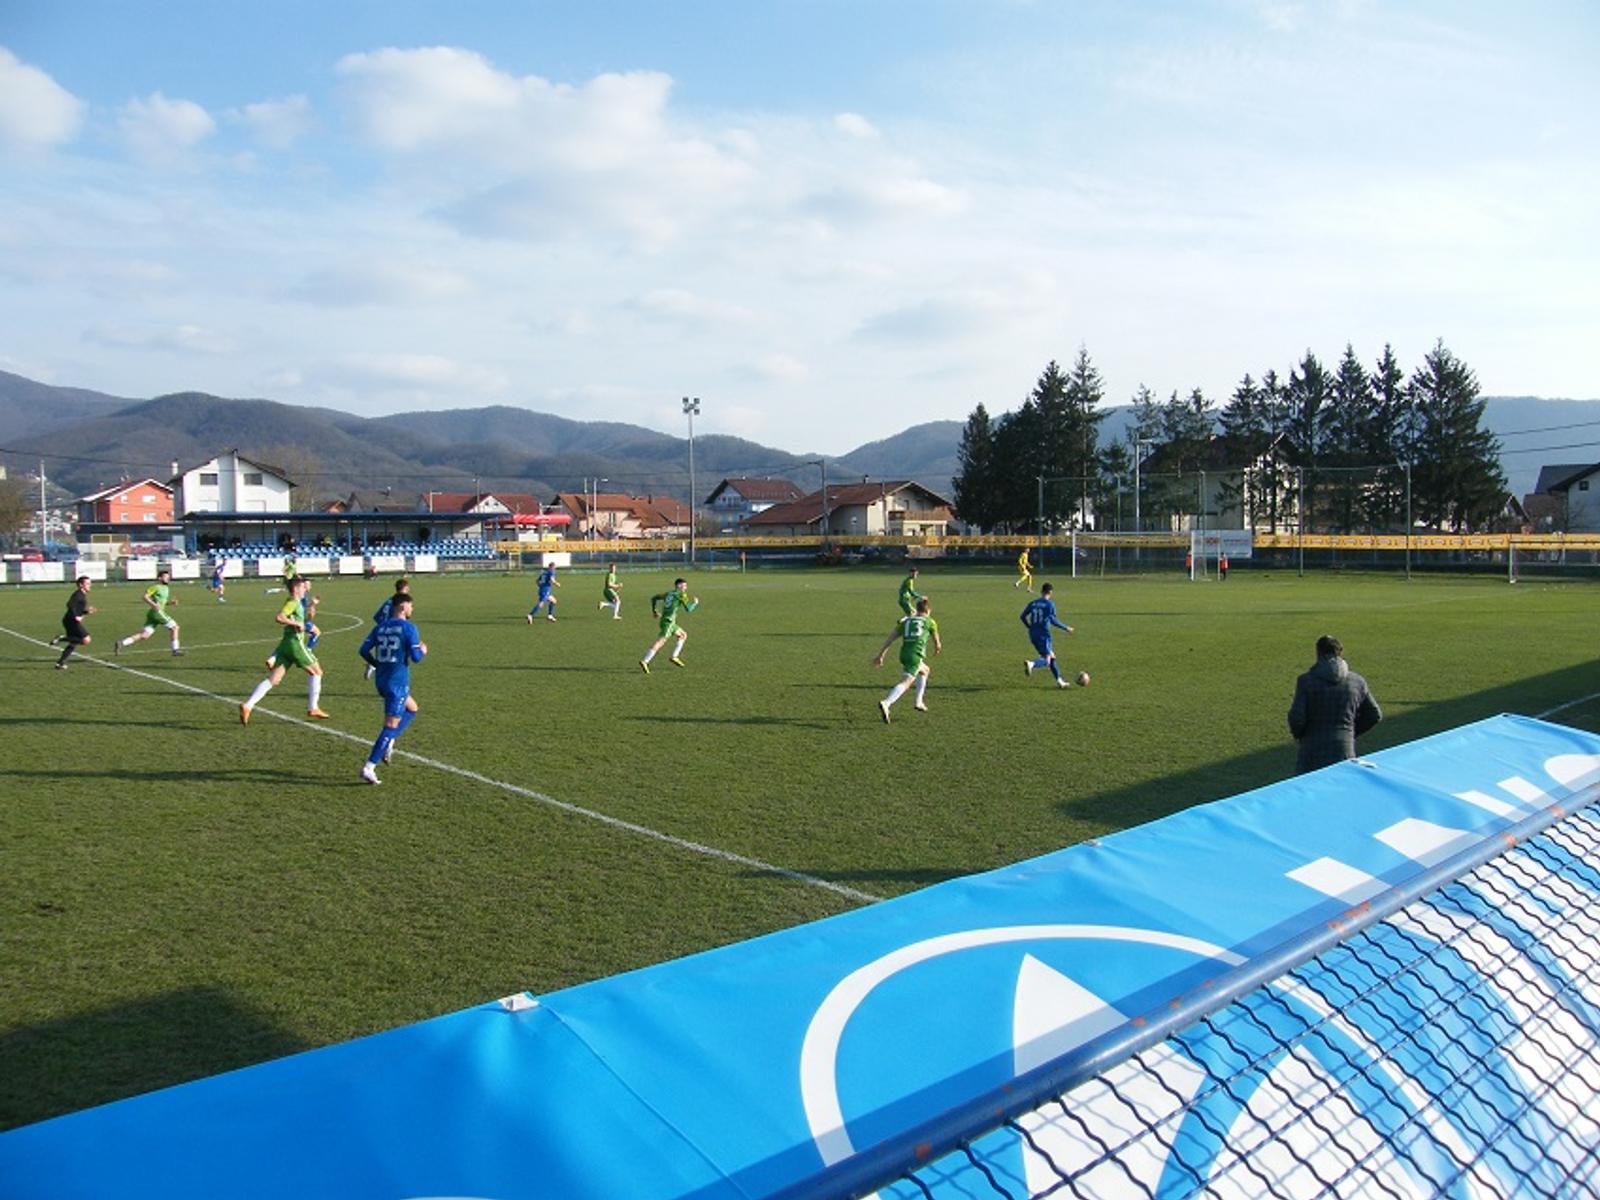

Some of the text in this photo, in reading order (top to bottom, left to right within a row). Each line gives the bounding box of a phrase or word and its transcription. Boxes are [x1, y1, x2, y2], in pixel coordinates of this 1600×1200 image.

[1032, 608, 1044, 624] 11
[904, 620, 925, 637] 13
[377, 635, 400, 662] 22
